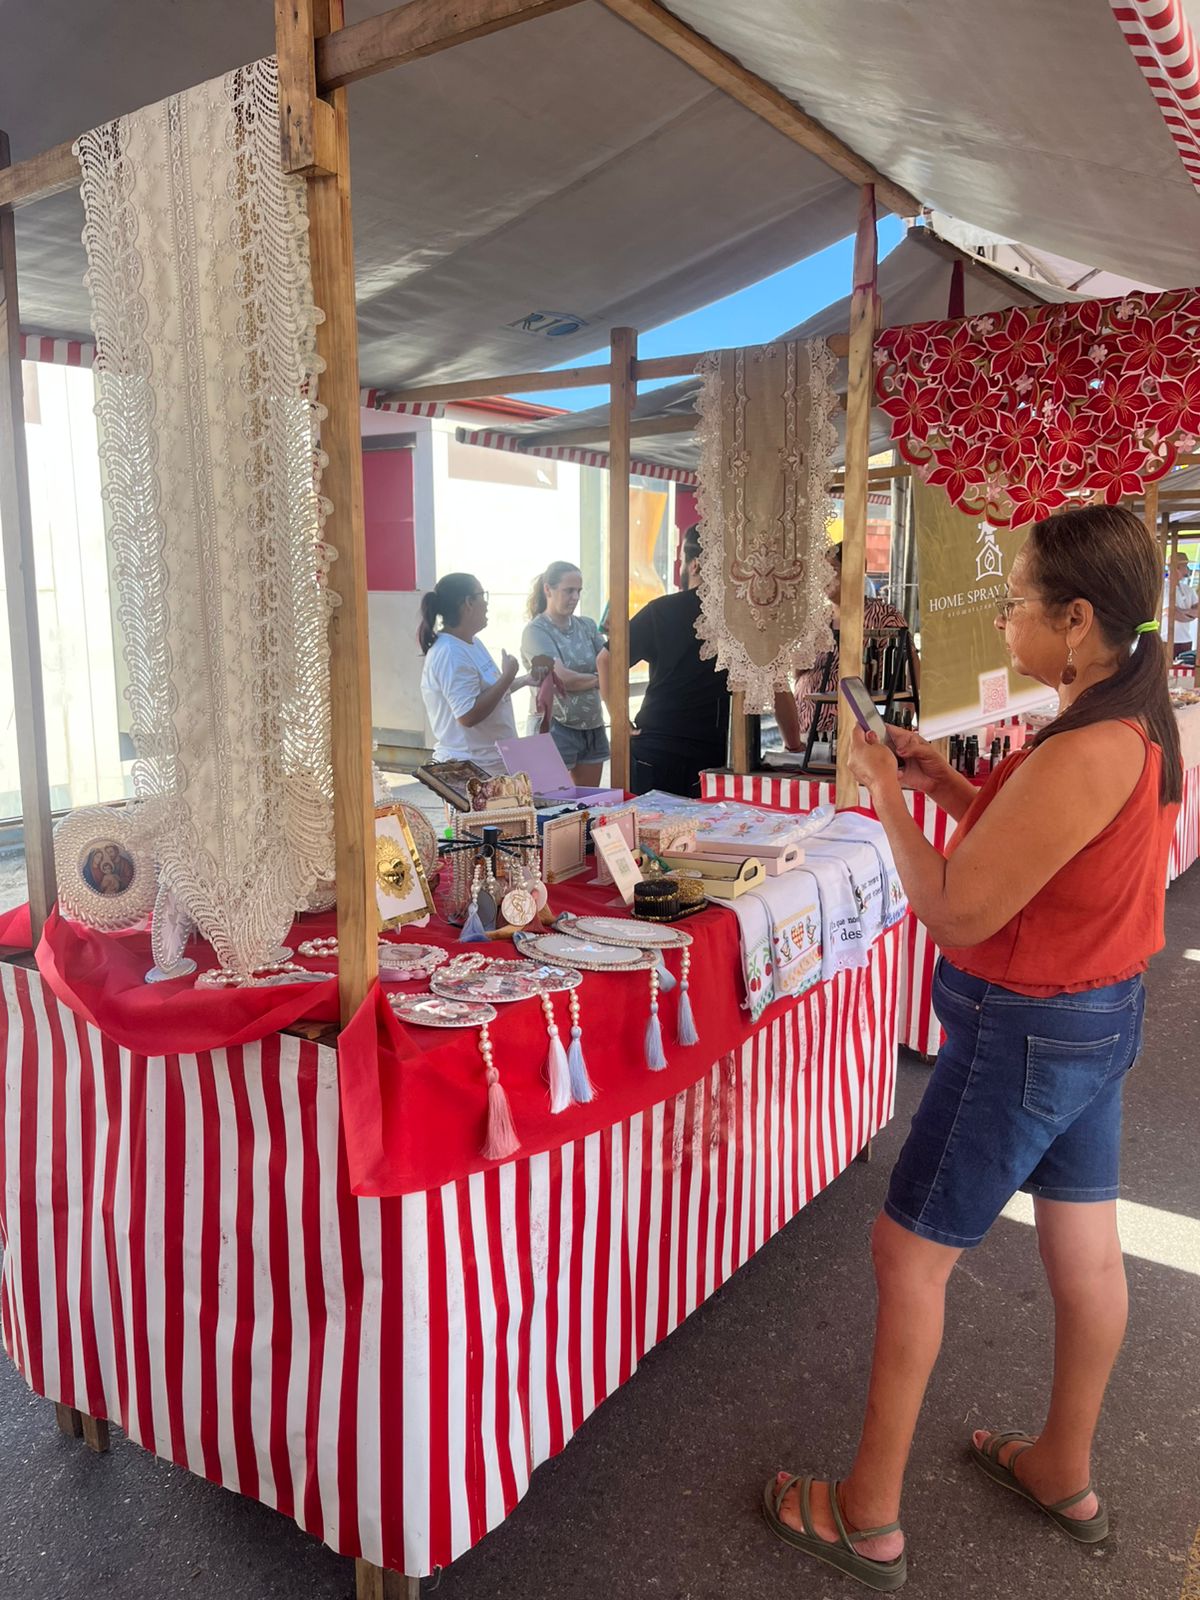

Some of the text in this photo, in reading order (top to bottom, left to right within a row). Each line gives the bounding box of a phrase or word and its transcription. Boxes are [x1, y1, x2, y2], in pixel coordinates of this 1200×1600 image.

[930, 593, 964, 612] HOME
[967, 585, 1001, 603] SPRAY
[840, 928, 863, 942] des
